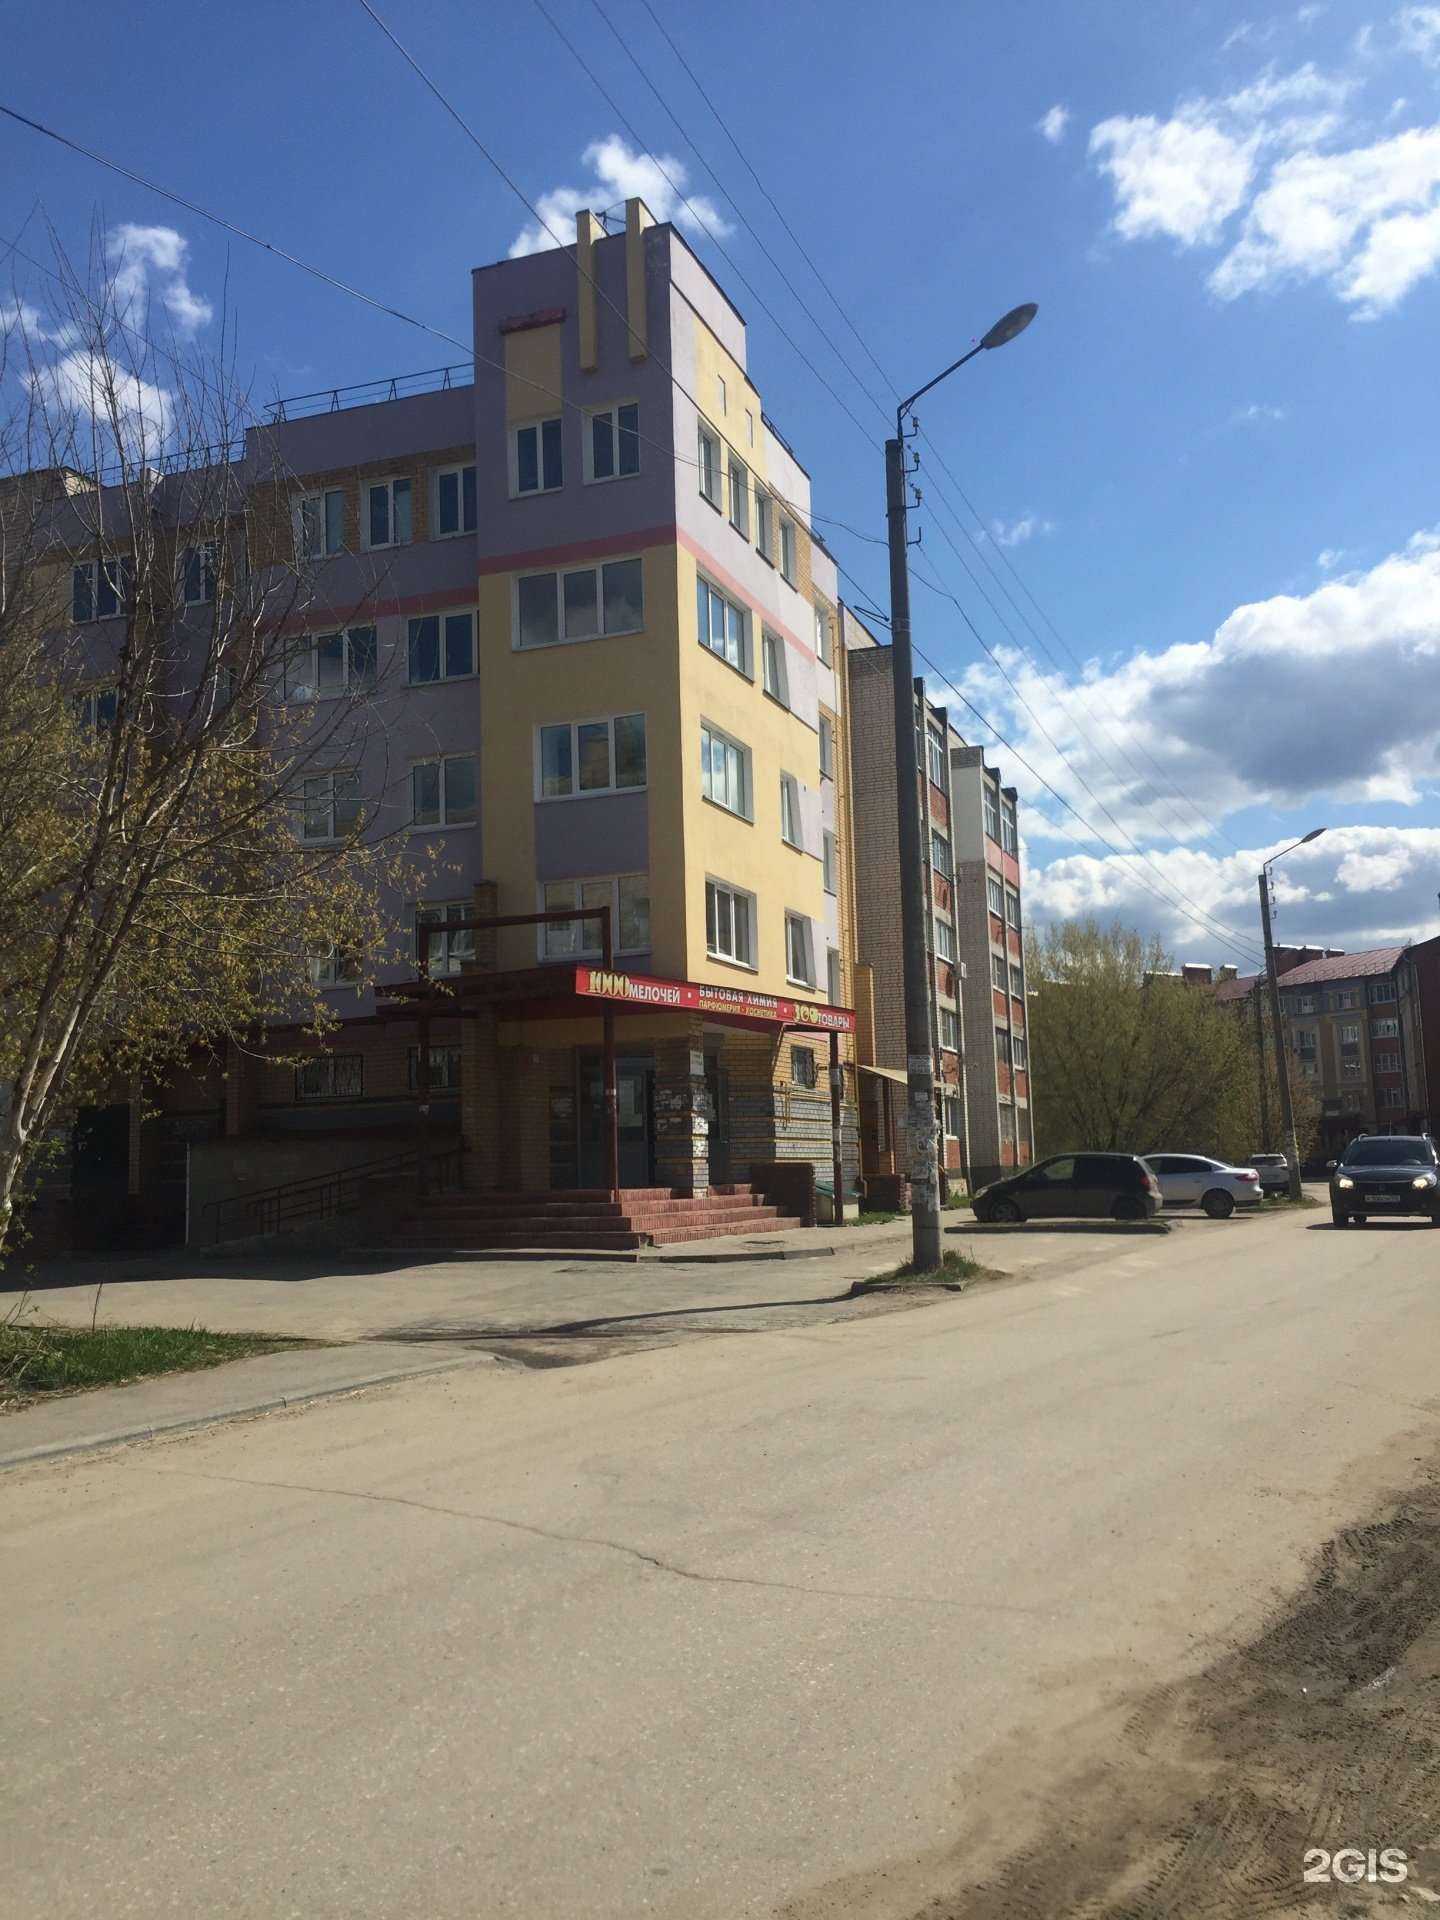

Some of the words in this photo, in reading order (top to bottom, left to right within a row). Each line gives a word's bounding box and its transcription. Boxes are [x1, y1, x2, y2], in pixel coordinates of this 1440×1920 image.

[629, 984, 680, 1004] МЕЛОЧЕЙ
[699, 985, 744, 1003] БЫТОВАЯ
[747, 993, 778, 1009] ХИМИЯ
